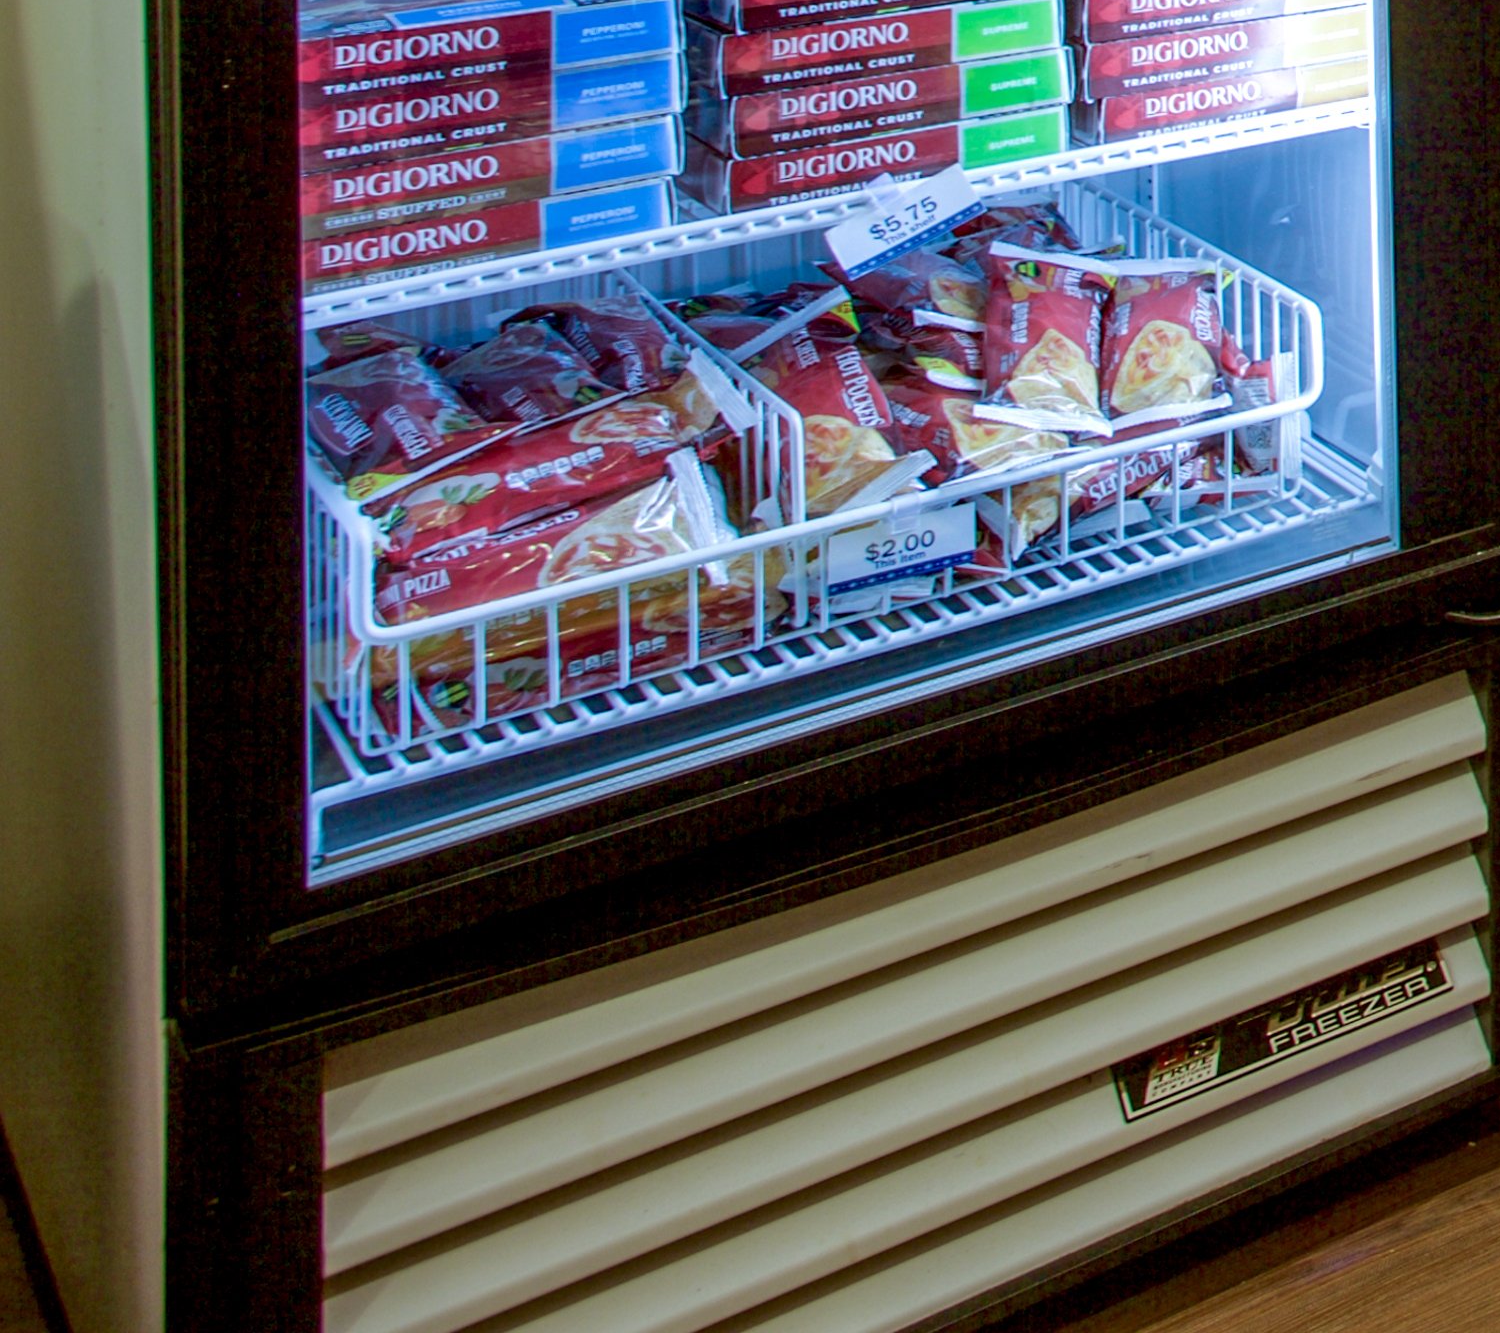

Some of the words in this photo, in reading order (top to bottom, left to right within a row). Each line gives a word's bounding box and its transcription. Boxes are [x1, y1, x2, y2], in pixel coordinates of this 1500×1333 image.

[334, 26, 500, 69] DIGIORNO
[323, 69, 445, 95] TRADITIONAL
[452, 61, 508, 78] CRUST
[335, 87, 500, 133] DIGIORNO
[324, 133, 445, 160] TRADITIONAL
[452, 122, 508, 140] CRUST
[333, 155, 500, 202] DIGIORNO
[376, 193, 468, 224] STUFFED
[868, 195, 939, 241] $5.75
[320, 217, 489, 268] DIGIORNO
[864, 529, 936, 563] $2.00
[403, 567, 451, 599] PIZZA
[1270, 975, 1430, 1055] FREEZER
